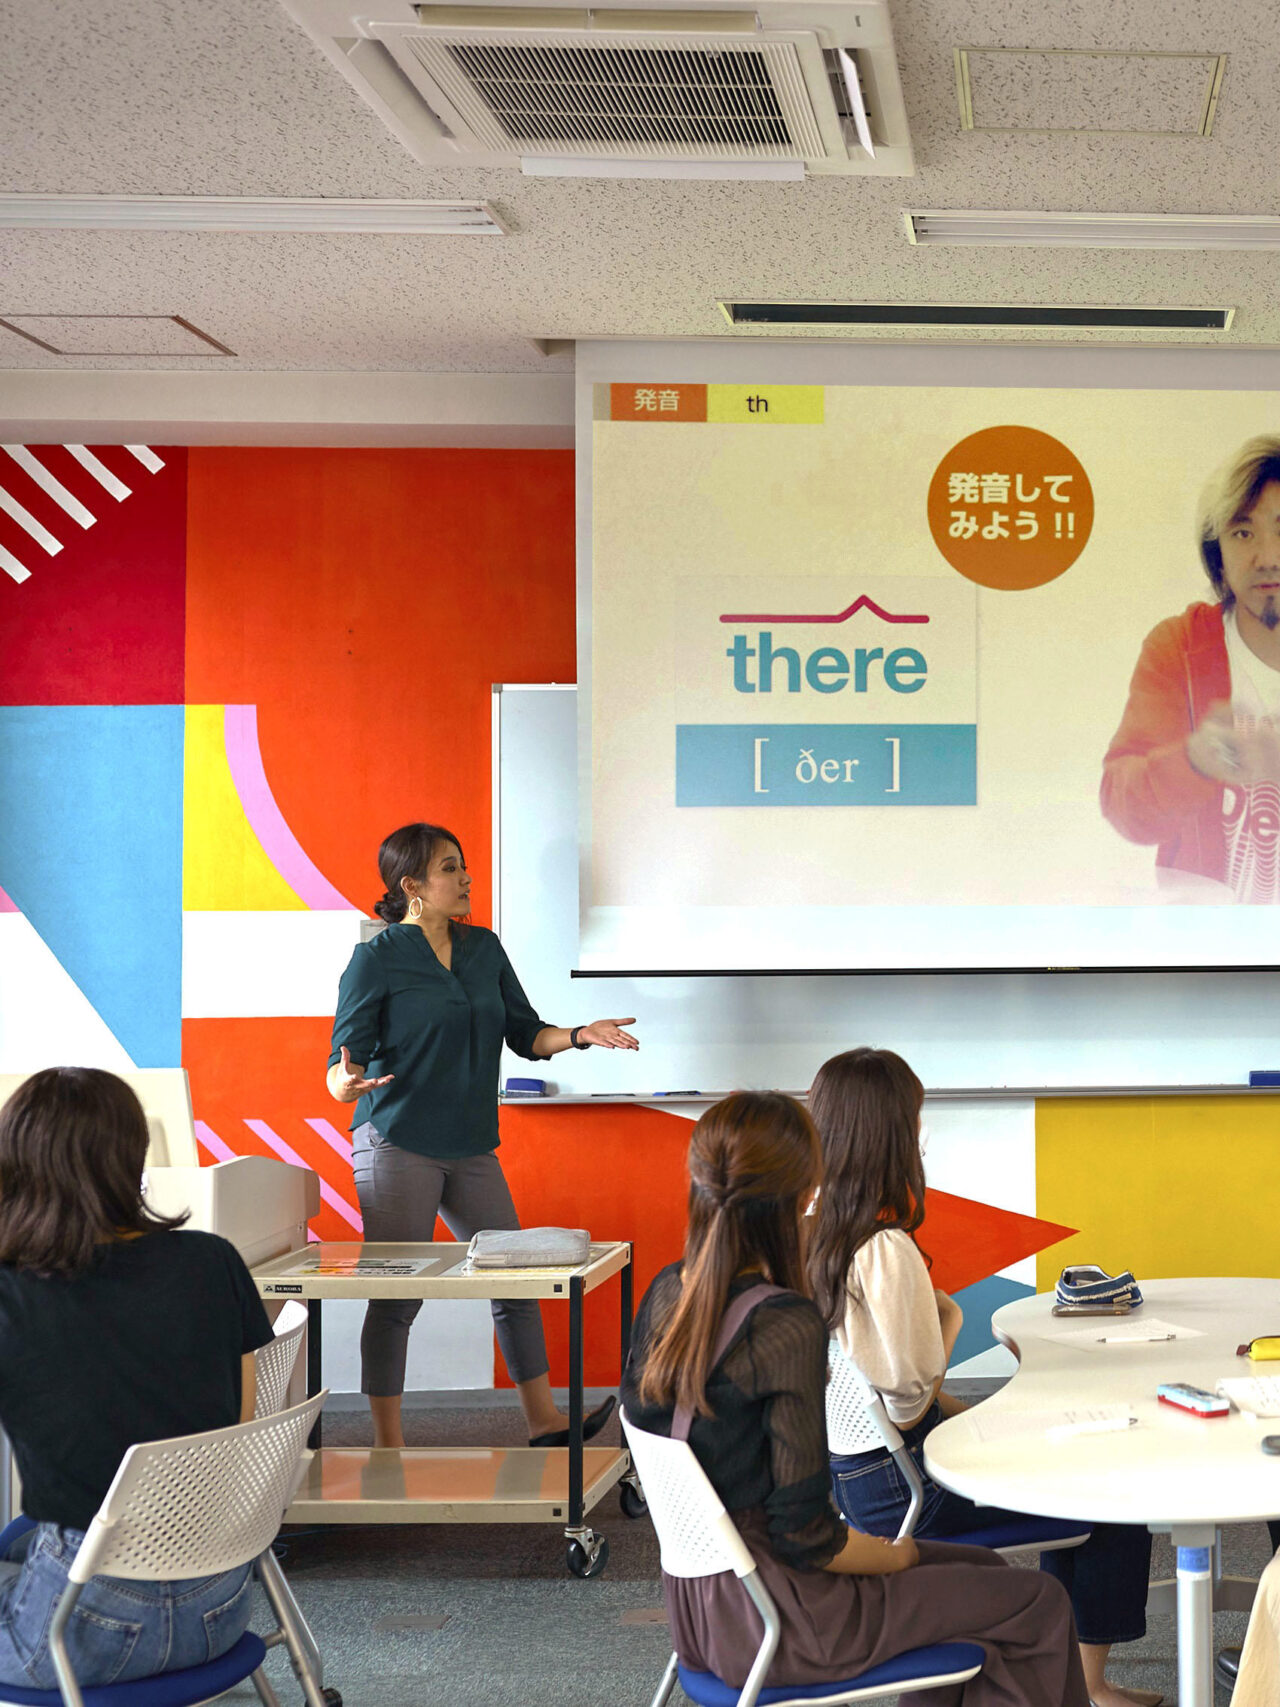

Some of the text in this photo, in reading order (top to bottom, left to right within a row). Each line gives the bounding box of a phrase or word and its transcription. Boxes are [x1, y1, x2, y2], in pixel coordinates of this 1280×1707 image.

[634, 388, 680, 412] 発音
[746, 394, 769, 413] th
[947, 472, 1073, 504] 発音して
[726, 631, 928, 694] there
